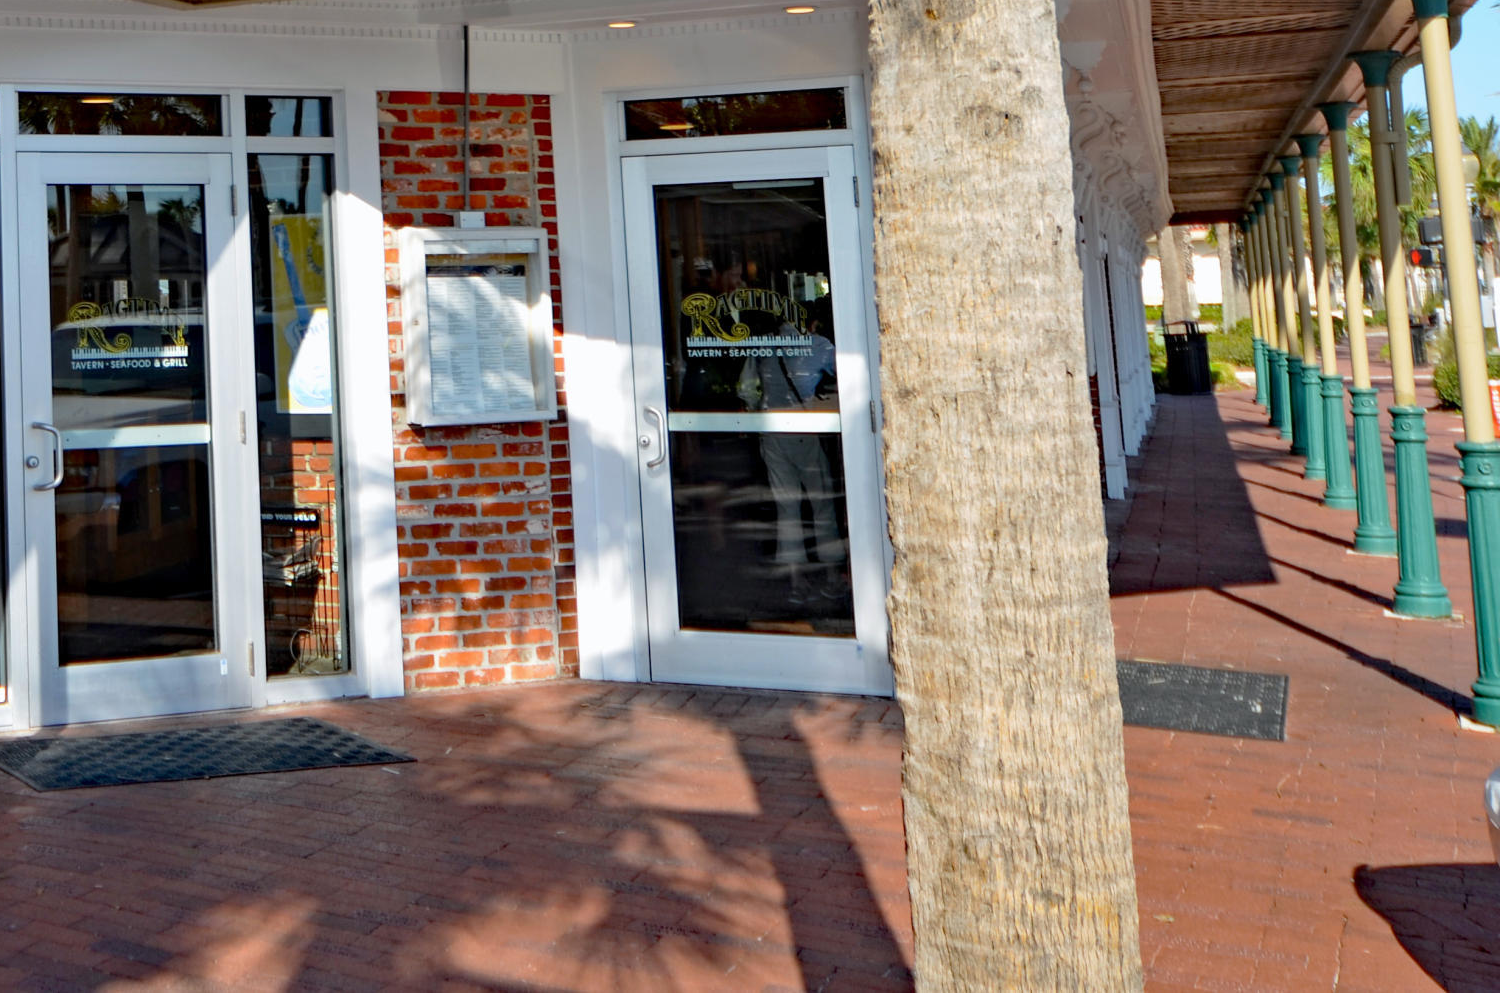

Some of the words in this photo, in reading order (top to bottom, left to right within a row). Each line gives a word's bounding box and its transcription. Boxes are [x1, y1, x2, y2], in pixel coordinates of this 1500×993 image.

[681, 288, 808, 343] RAGTIME
[687, 348, 722, 358] TAVERN
[729, 347, 773, 357] SEAFOOD
[777, 347, 784, 357] &
[787, 347, 813, 357] GRILL
[71, 360, 105, 370] TAVERN
[110, 358, 151, 369] SEAFOOD
[153, 359, 161, 368] &
[162, 357, 188, 368] GRILL
